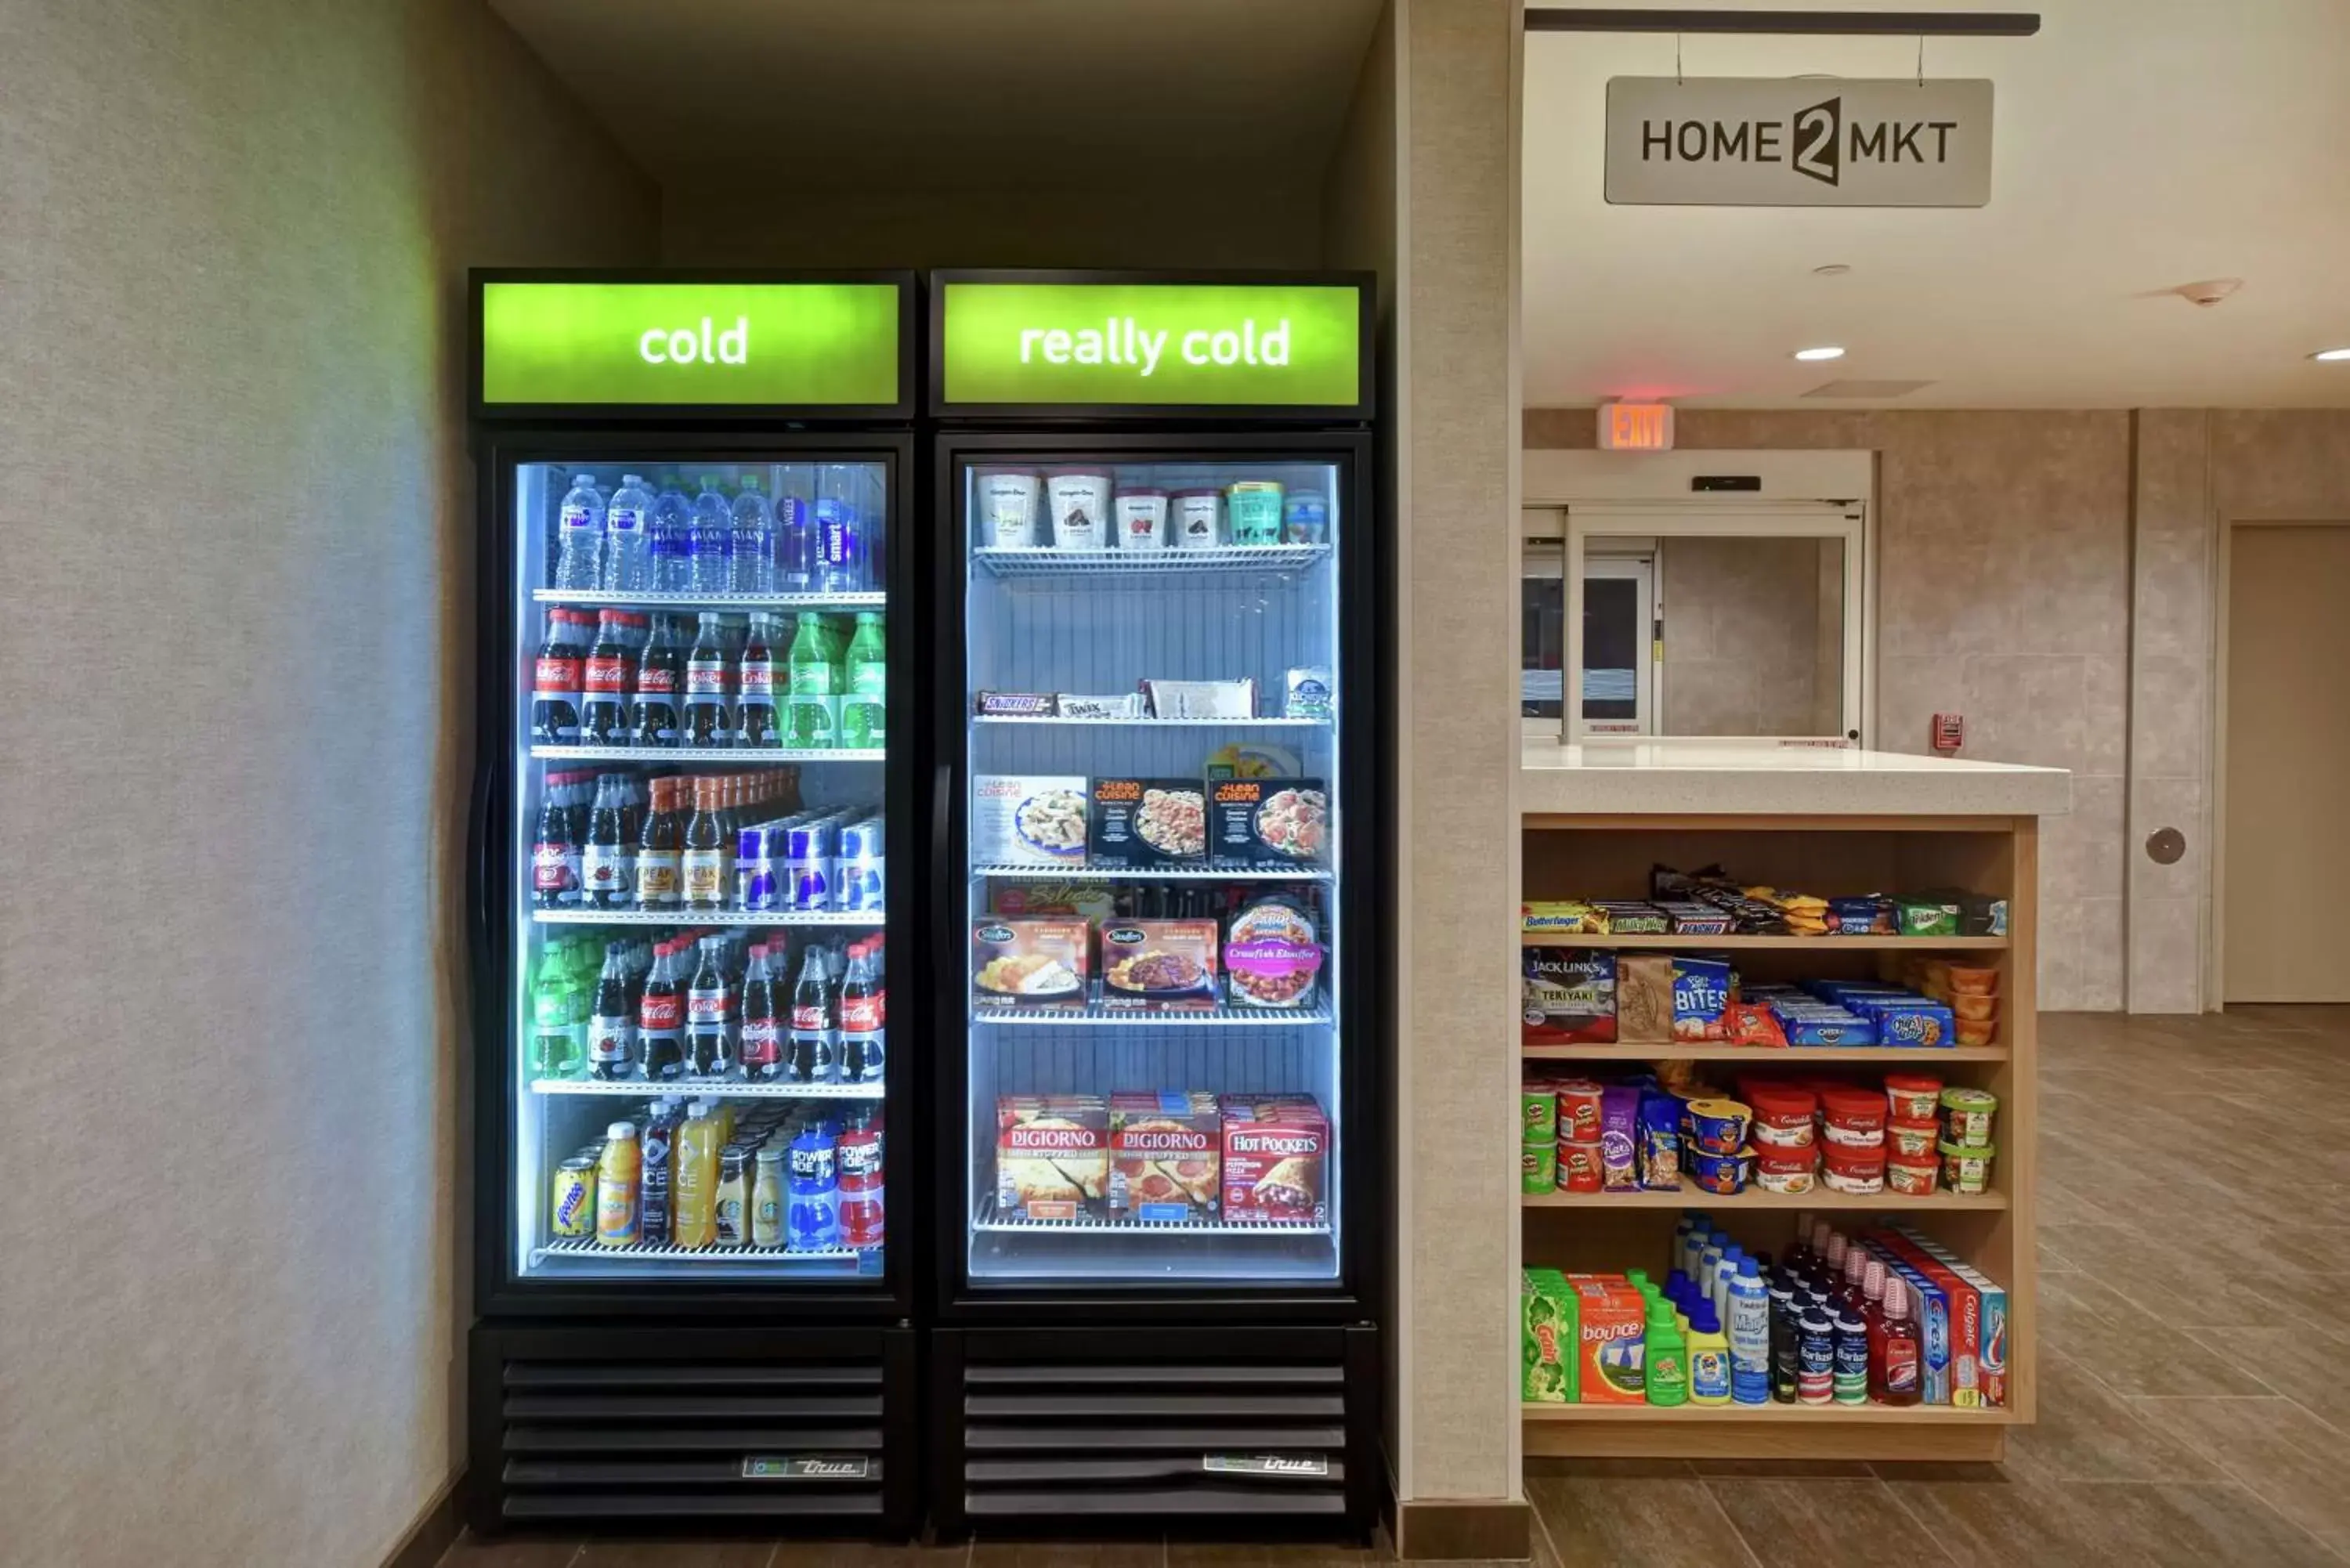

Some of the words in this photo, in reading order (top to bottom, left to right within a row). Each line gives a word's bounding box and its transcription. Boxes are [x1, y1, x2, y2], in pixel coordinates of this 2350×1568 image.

[639, 316, 749, 365] cold
[1019, 317, 1167, 377] really
[1182, 318, 1291, 367] cold
[1532, 961, 1563, 974] JACK
[1541, 990, 1593, 1001] TERIYAKI
[1011, 1130, 1097, 1147] DIGIORNO
[1123, 1133, 1207, 1149] DIGIORNO
[1234, 1136, 1260, 1151] HOT
[1261, 1136, 1318, 1153] POCKETS
[1965, 1294, 1977, 1347] Colgate
[1582, 1322, 1640, 1341] bounce
[1929, 1299, 1943, 1364] Crest
[796, 1459, 857, 1474] True
